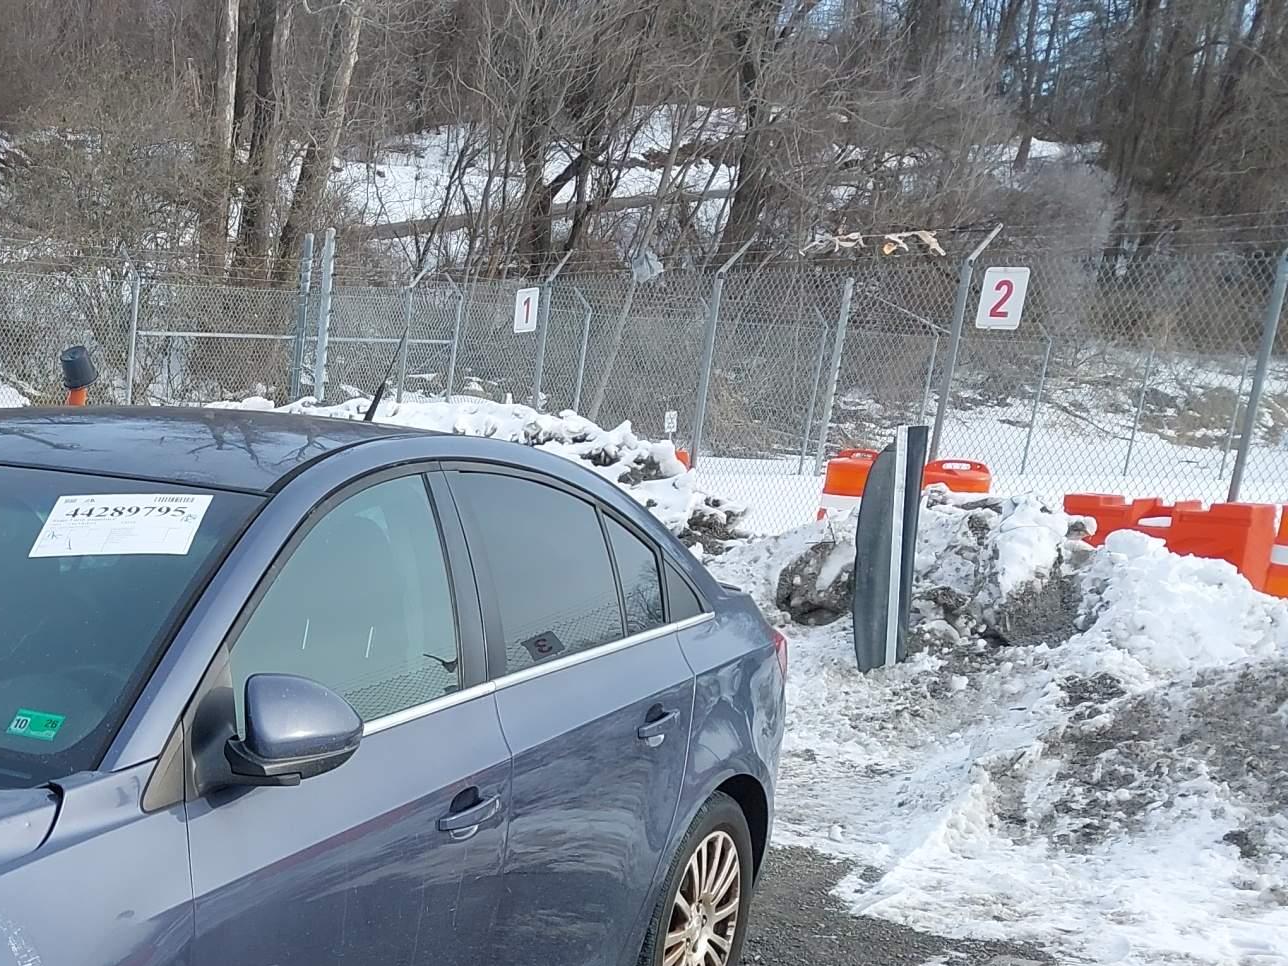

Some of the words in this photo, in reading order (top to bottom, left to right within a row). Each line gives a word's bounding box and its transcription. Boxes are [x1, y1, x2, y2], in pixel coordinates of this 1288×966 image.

[989, 279, 1014, 318] 2
[523, 296, 531, 324] 1
[65, 505, 187, 518] 44289795
[14, 718, 29, 730] 10
[44, 719, 59, 729] 26
